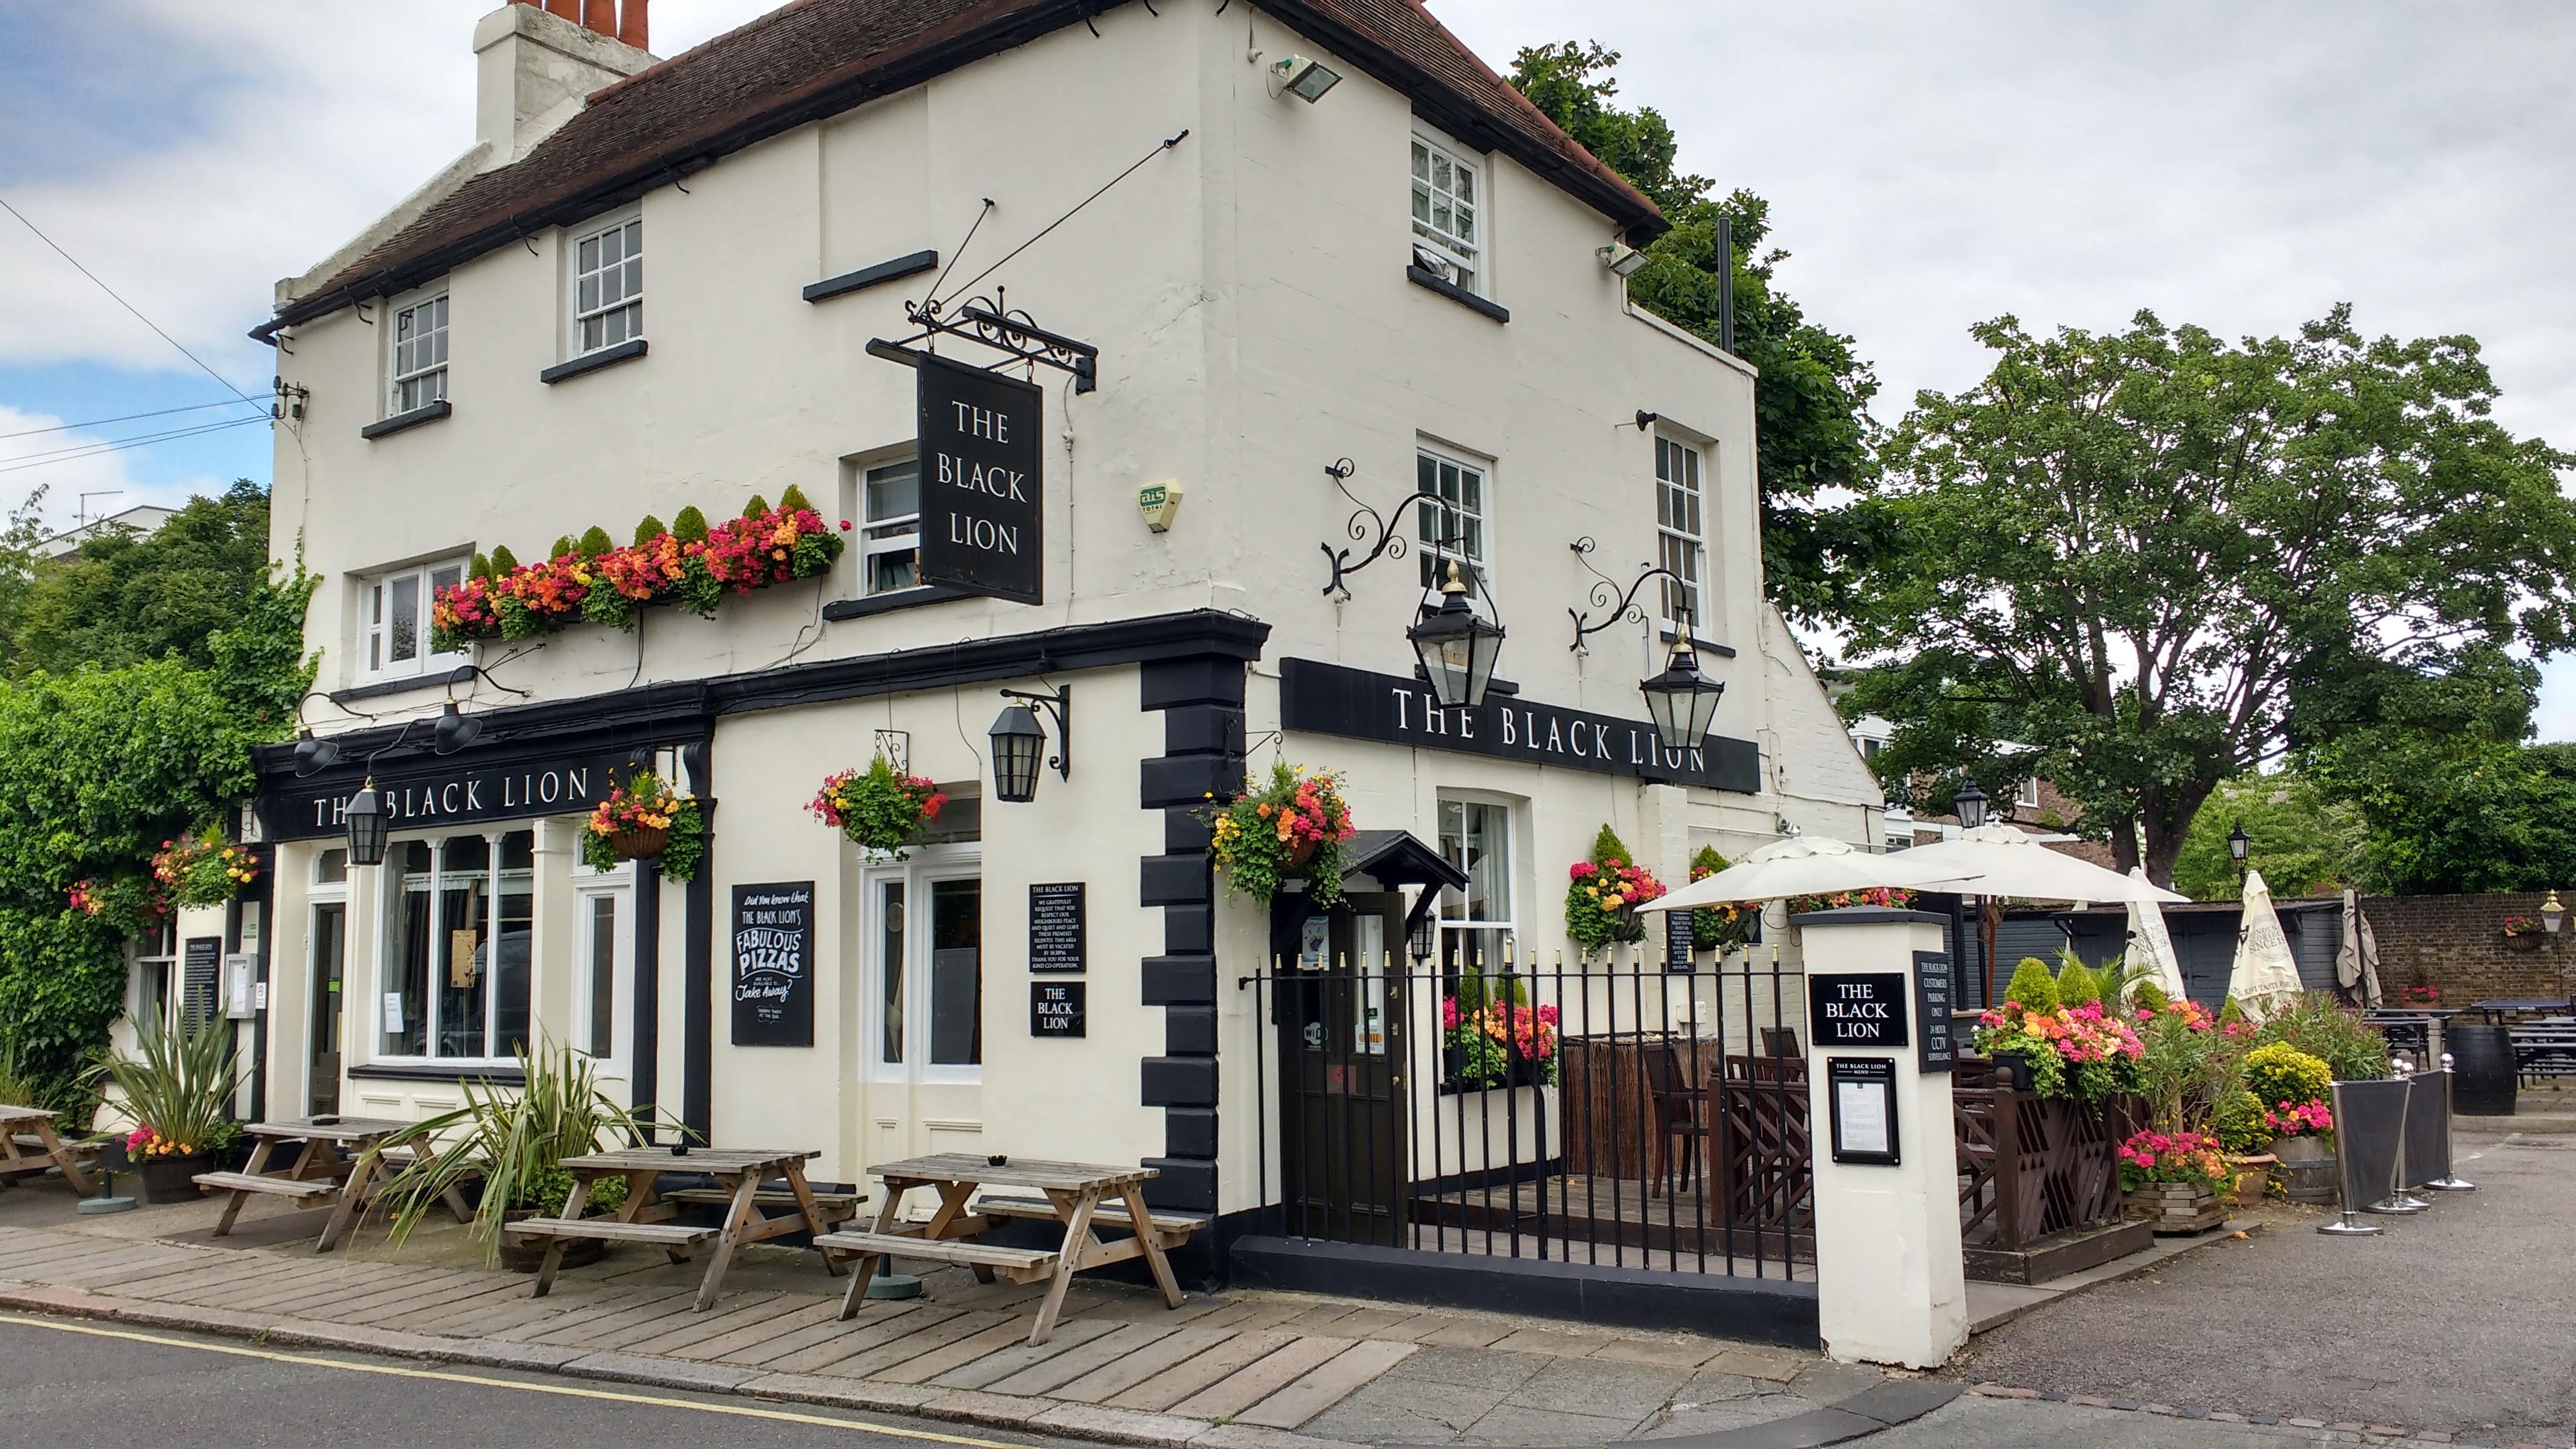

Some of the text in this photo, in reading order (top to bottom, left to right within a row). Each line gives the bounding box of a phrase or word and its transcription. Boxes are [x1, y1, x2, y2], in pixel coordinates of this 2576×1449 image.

[952, 400, 1009, 444] THE
[937, 453, 1027, 503] BLACK
[949, 512, 1019, 555] LION
[1393, 688, 1705, 773] THE BLACK LION
[313, 768, 588, 827] TH BLACK LION
[744, 890, 809, 905] Did You know that
[742, 908, 801, 926] THE BLACK LION'S
[736, 929, 802, 954] FABULOUS
[2248, 938, 2277, 954] SINCE
[739, 949, 800, 976] PIZZAS
[1928, 962, 1939, 971] BLACK
[1939, 963, 1947, 972] LION
[736, 978, 793, 1003] Take Away?
[1923, 978, 1947, 988] CUSTOMERS
[1045, 988, 1066, 999] THE
[1837, 984, 1873, 999] THE
[1927, 993, 1946, 1003] PARKING
[1038, 1002, 1074, 1014] BLACK
[1825, 1003, 1889, 1018] BLACK
[1931, 1007, 1943, 1017] ONLY
[1043, 1017, 1068, 1029] LION
[1836, 1023, 1880, 1037] LION
[1930, 1025, 1947, 1034] 24 HOUR
[1931, 1037, 1947, 1050] CCTV
[1928, 1052, 1951, 1061] SURVEILLANCE
